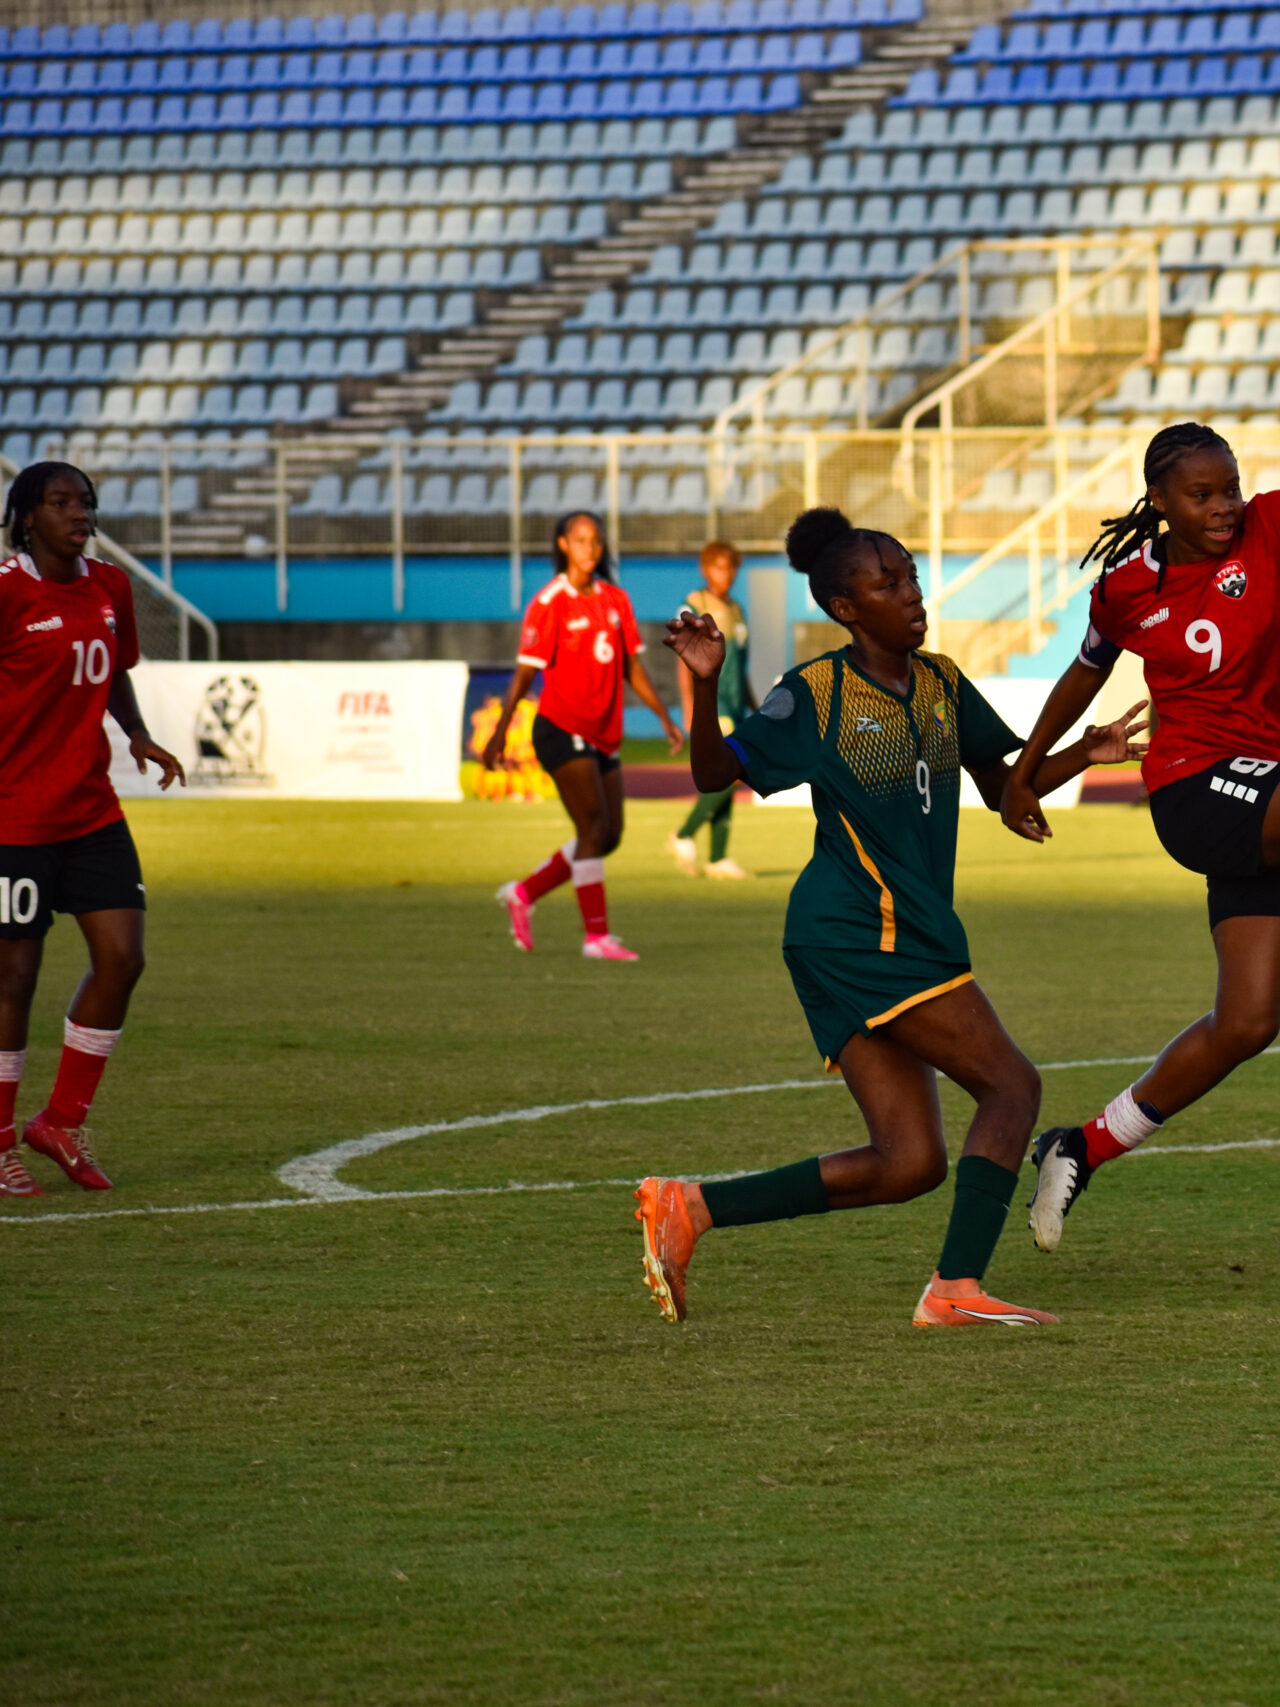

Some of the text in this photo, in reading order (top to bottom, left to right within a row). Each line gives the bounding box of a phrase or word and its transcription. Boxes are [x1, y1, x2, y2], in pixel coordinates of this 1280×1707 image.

[26, 616, 63, 632] capelli
[1140, 607, 1169, 629] capelli
[72, 639, 110, 685] 10
[593, 630, 614, 664] 6
[1185, 619, 1222, 672] 9
[337, 691, 391, 717] FIFA
[1229, 756, 1279, 777] 9
[916, 760, 931, 814] 9
[0, 876, 39, 924] 10
